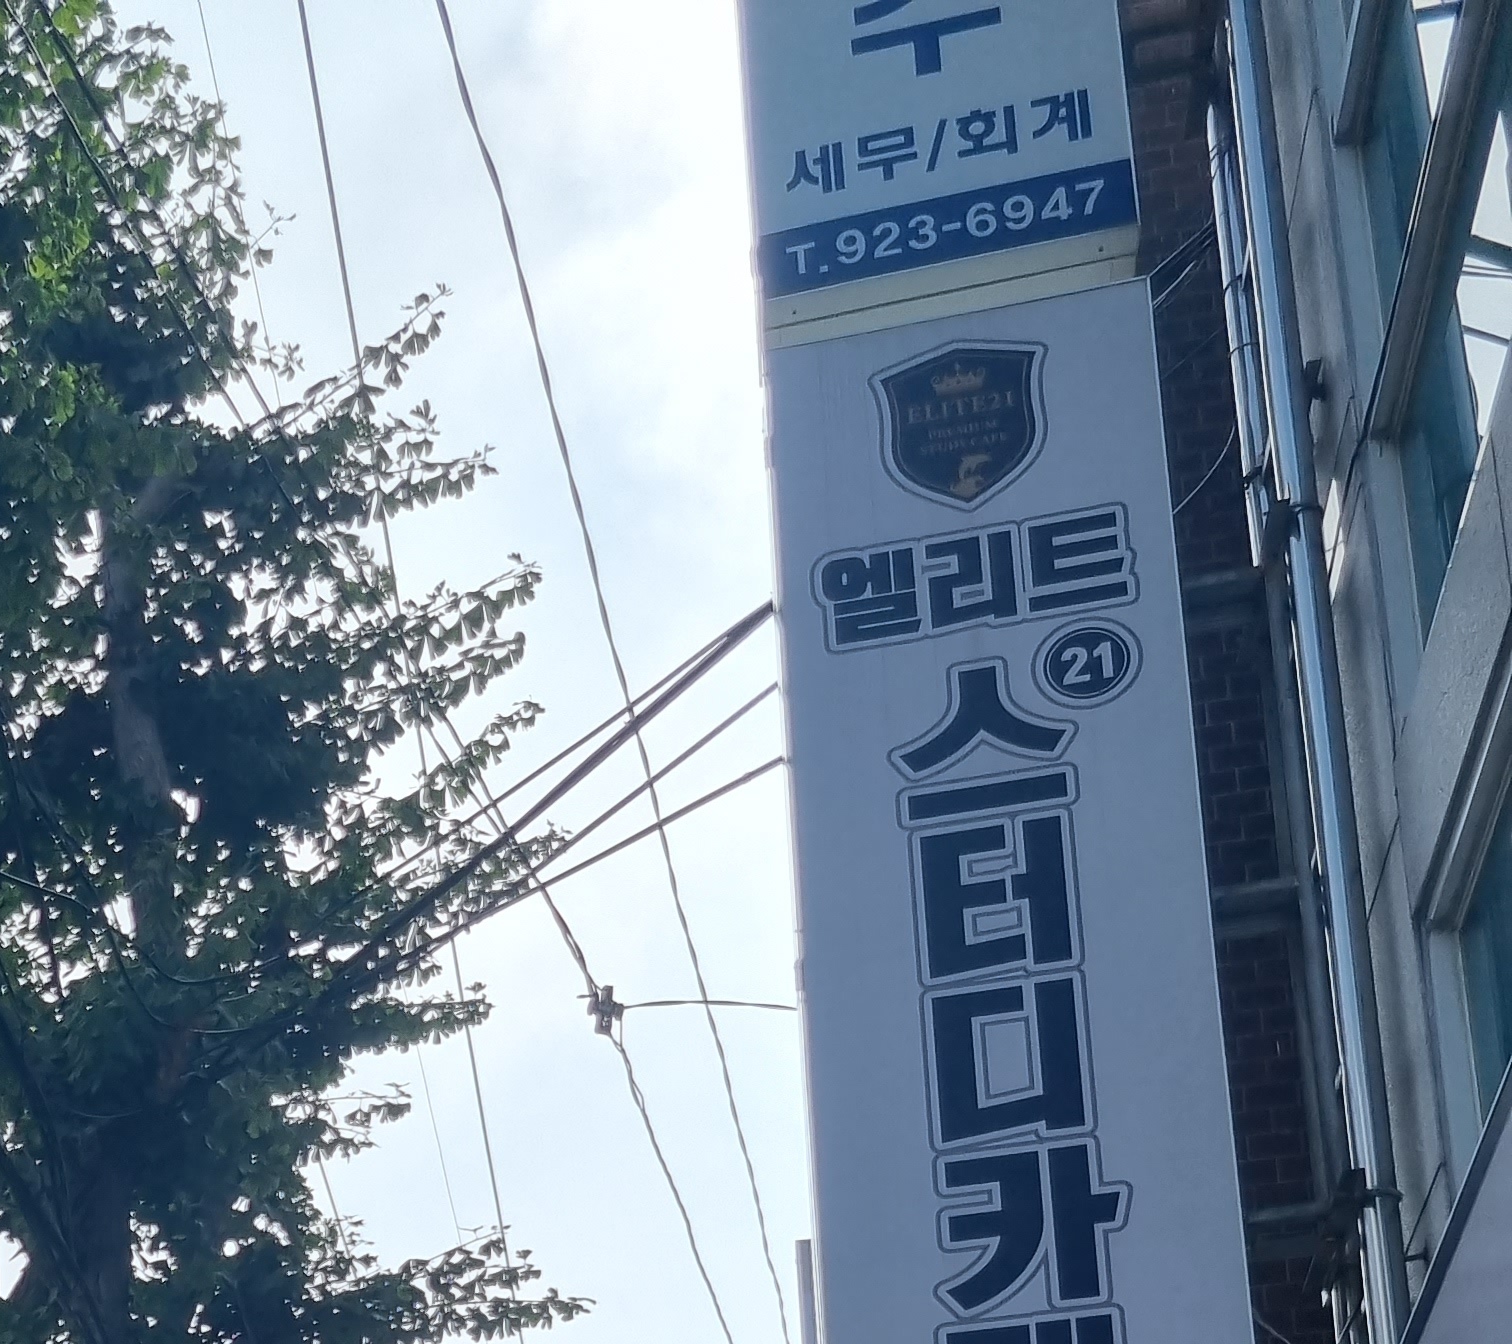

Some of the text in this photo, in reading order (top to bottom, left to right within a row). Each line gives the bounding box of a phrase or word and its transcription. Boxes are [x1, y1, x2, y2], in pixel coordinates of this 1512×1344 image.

[785, 87, 1093, 194] 세무/회계
[785, 178, 1106, 276] T.923-6947
[819, 510, 1134, 647] 엘리트
[1060, 636, 1117, 686] 21
